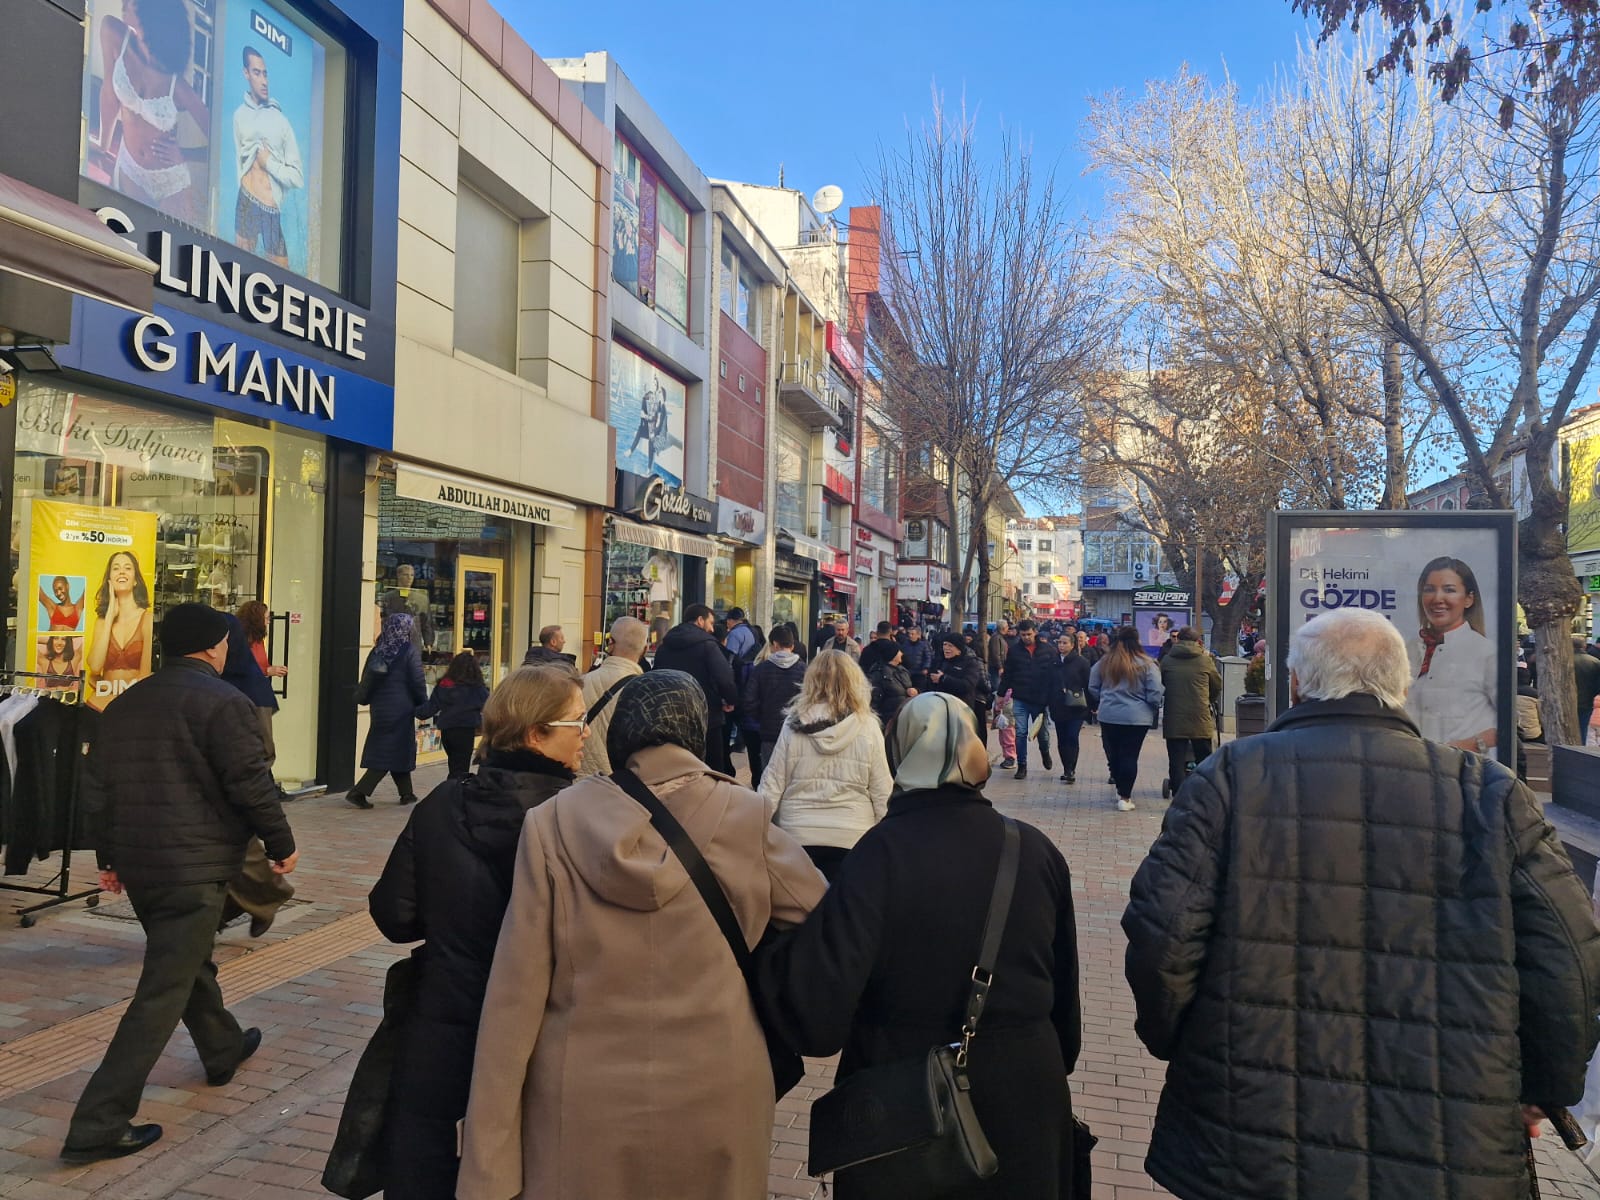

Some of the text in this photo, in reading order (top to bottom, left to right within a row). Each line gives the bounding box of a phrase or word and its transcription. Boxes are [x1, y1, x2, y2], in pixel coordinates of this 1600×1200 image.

[255, 14, 286, 50] DIM
[159, 230, 367, 361] LINGERIE
[133, 315, 335, 421] G MANN
[19, 404, 94, 441] Baki
[130, 472, 158, 482] Calvin
[438, 485, 551, 522] ABDULLAH DALYANCI
[643, 477, 690, 521] Gözde
[81, 530, 105, 543] %50
[1300, 567, 1369, 583] Diş Hekimi
[1300, 583, 1397, 610] GÖZDE
